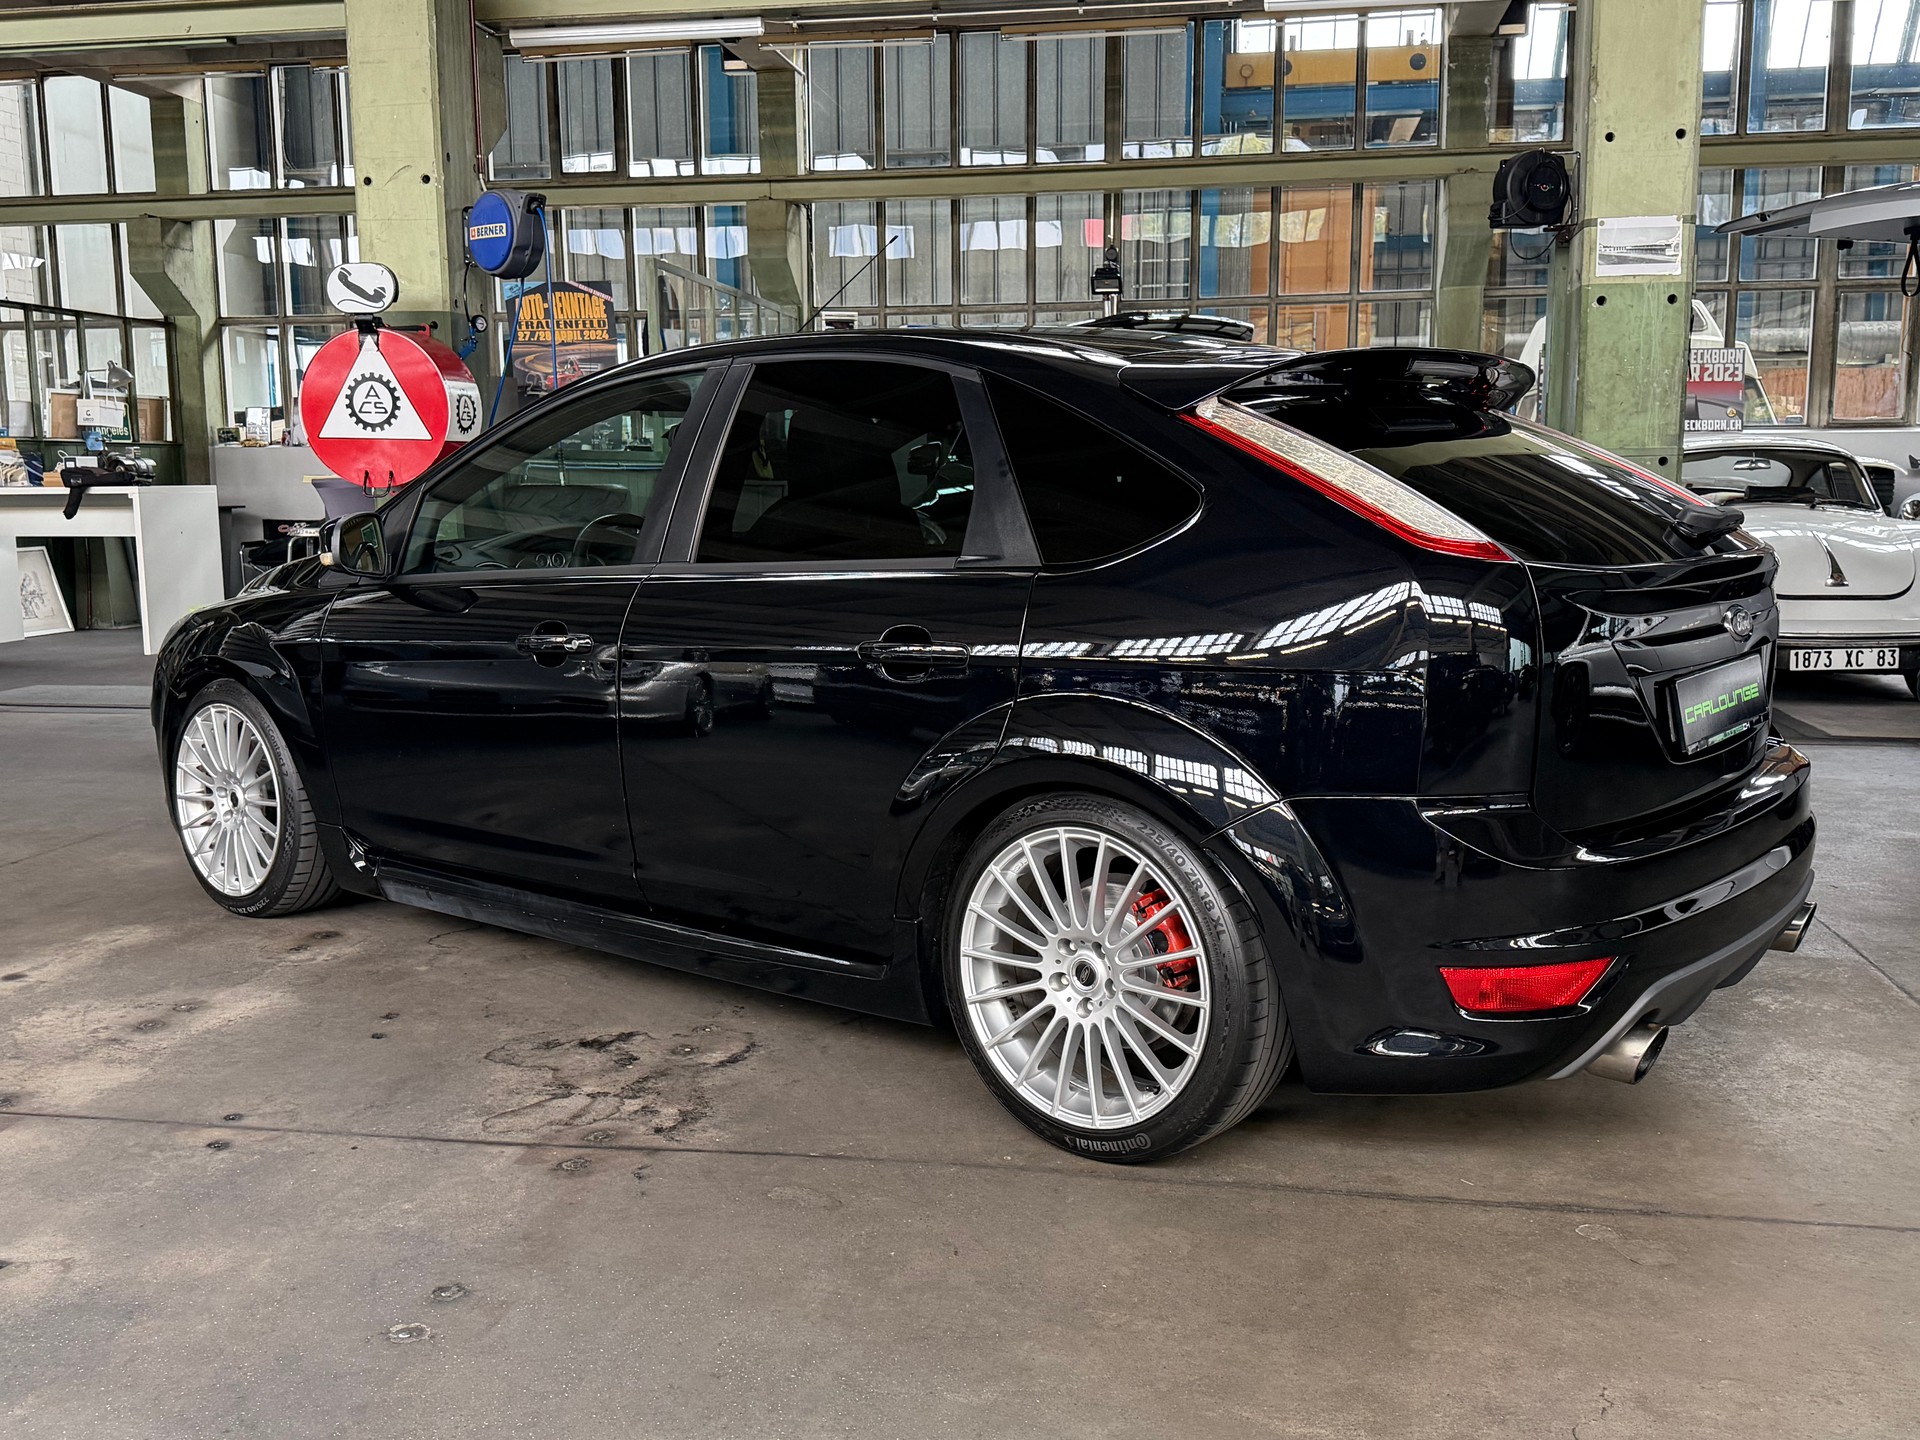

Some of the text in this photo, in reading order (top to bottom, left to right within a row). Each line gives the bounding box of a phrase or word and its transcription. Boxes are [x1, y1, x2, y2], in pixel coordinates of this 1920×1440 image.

[476, 225, 505, 237] BERNER
[555, 330, 582, 343] APRIL
[584, 331, 609, 340] 2024
[1690, 349, 1743, 364] ECKBORN
[1703, 363, 1743, 382] 2023
[365, 384, 381, 400] A
[1684, 419, 1742, 431] ECKBORN.CH
[1794, 649, 1897, 669] 1873 XC 83
[1684, 682, 1759, 725] CARLOUNGE
[1137, 822, 1186, 867] 225/40
[1184, 868, 1204, 892] ZR
[1200, 892, 1216, 913] 18
[1211, 915, 1227, 941] XL
[1075, 1132, 1152, 1154] Continental
